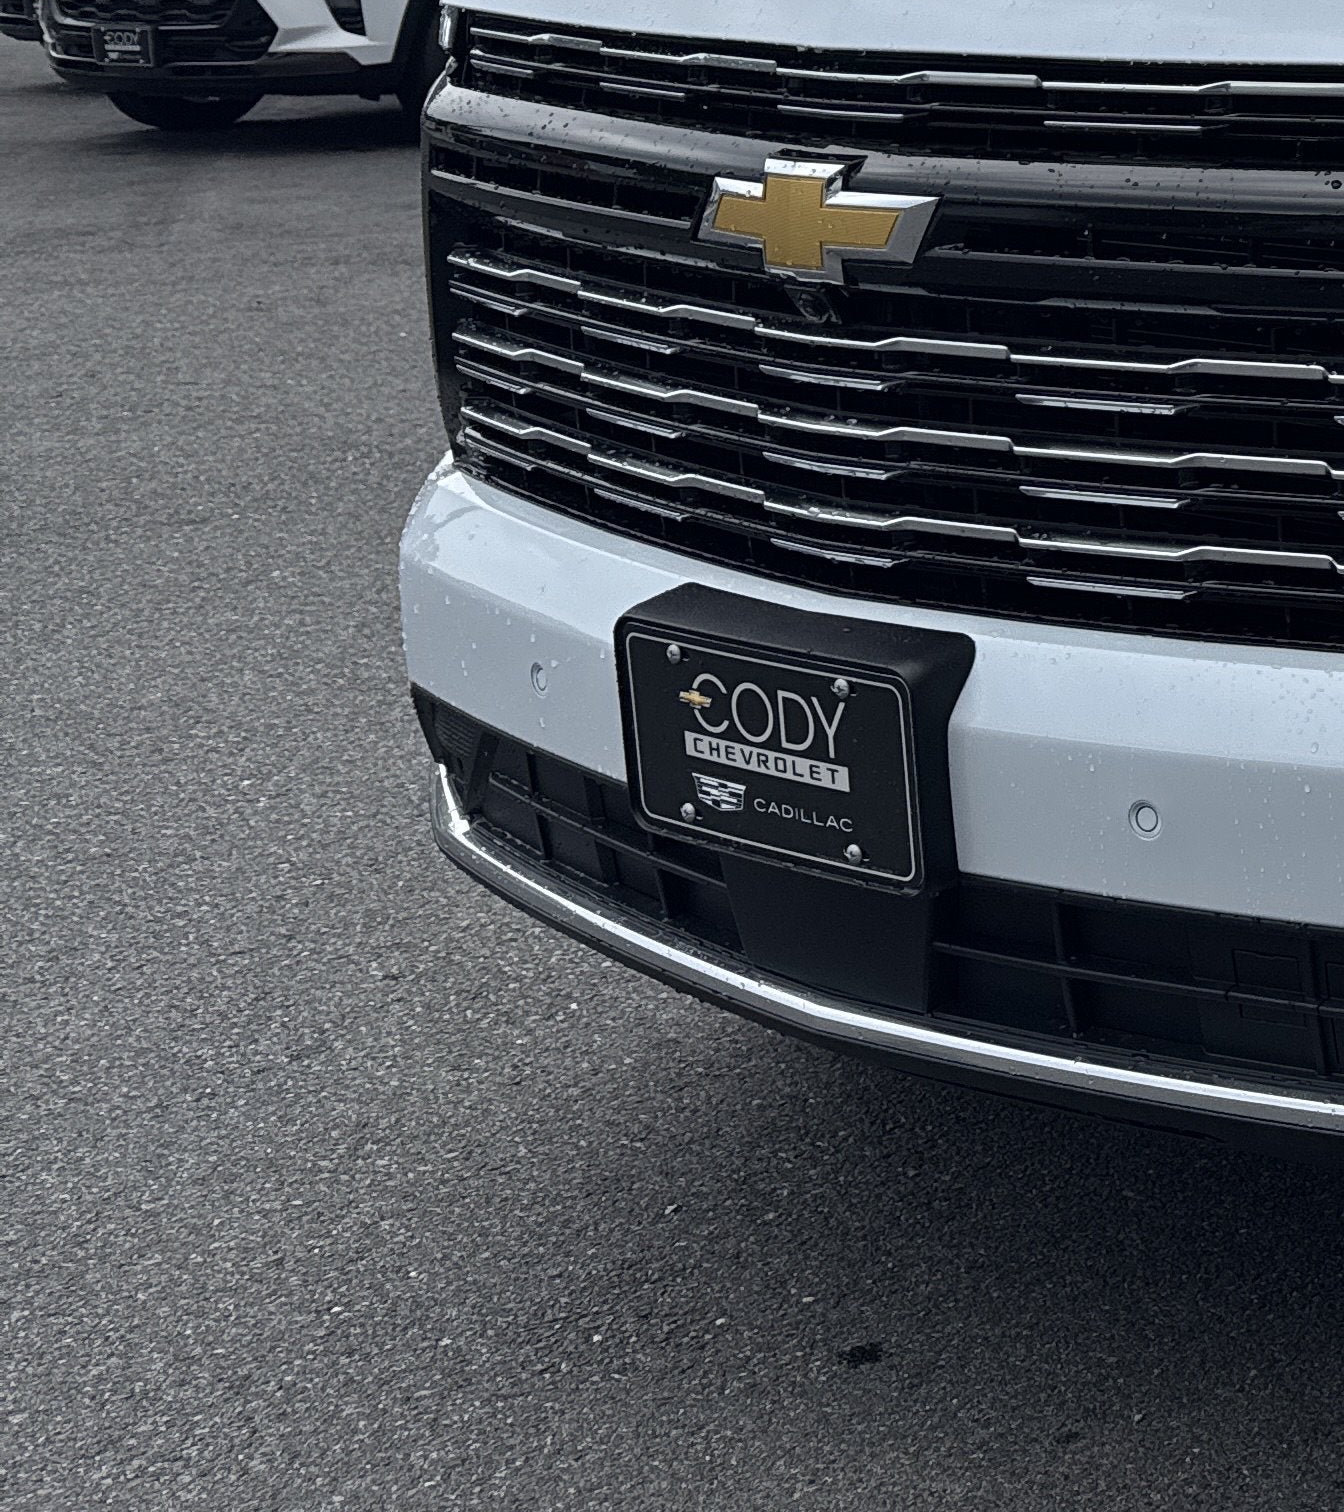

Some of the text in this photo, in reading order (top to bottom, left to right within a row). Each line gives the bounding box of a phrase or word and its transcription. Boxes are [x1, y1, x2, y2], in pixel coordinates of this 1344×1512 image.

[692, 673, 845, 759] CODY
[693, 737, 840, 786] CHEVROLET
[753, 798, 854, 832] CADILLAC
